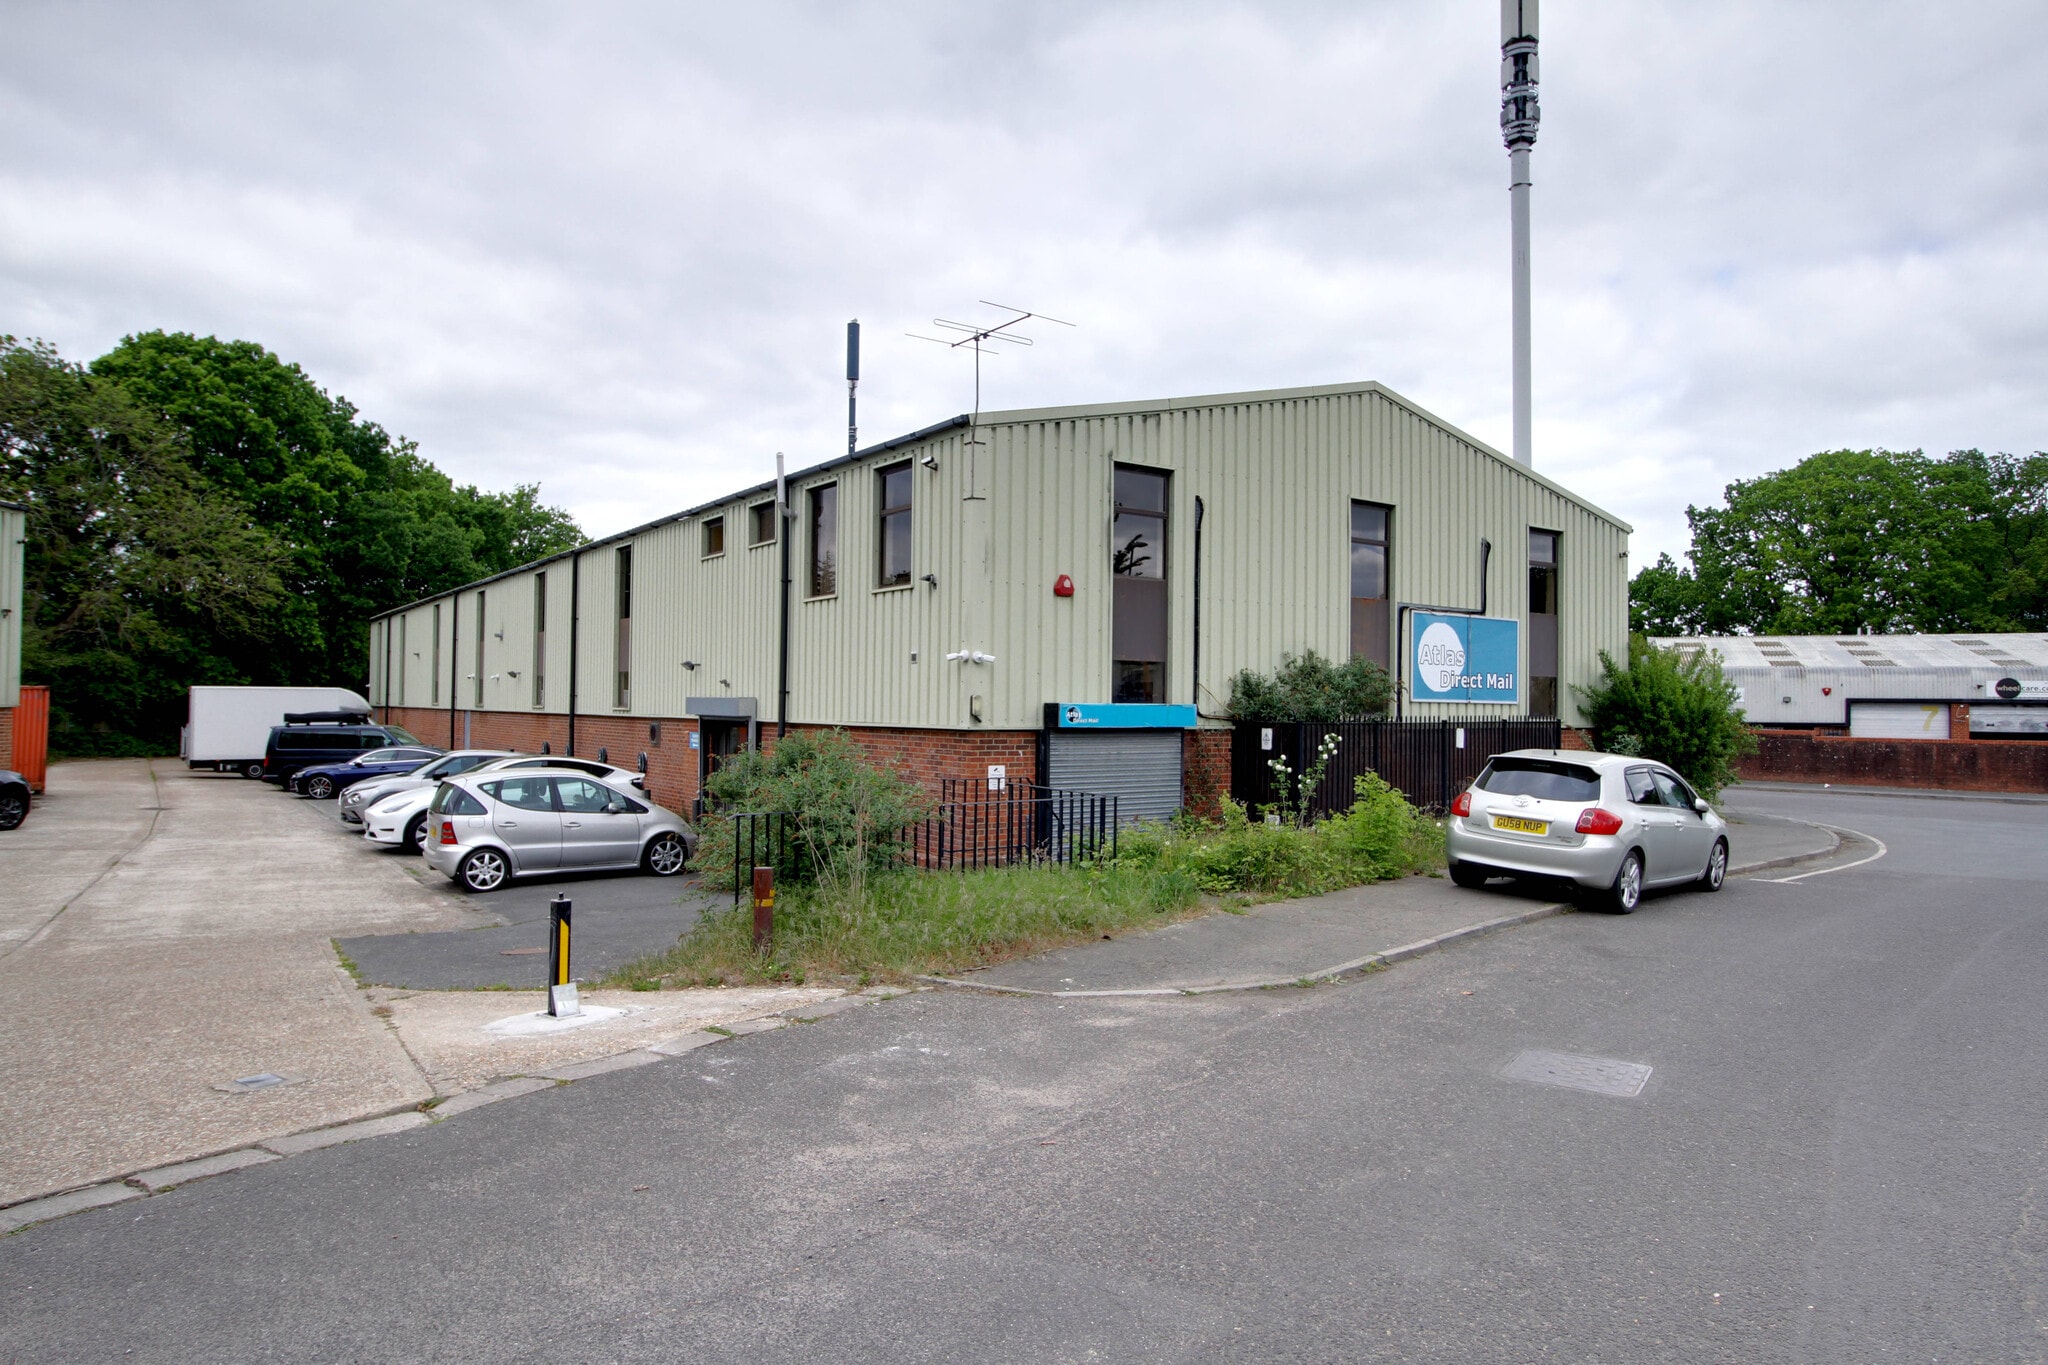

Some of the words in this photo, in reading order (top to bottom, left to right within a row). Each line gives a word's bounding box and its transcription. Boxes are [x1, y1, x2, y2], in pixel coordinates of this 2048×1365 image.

[1419, 644, 1465, 667] Atlas
[1440, 670, 1482, 688] Direct
[1486, 673, 1513, 690] Mail
[1920, 705, 1939, 731] 7
[1497, 817, 1521, 829] GU58
[1523, 821, 1543, 831] NUP
